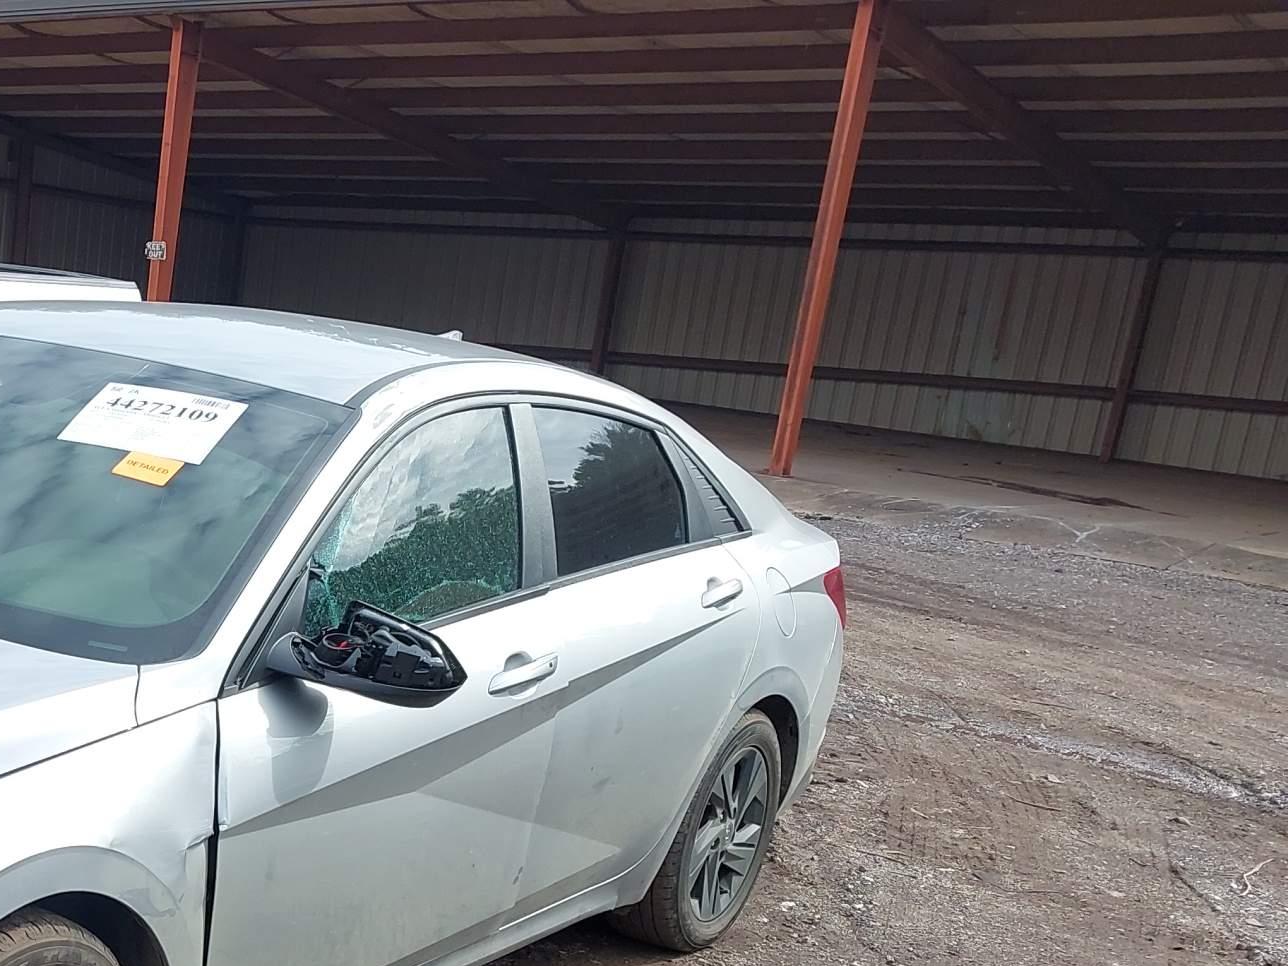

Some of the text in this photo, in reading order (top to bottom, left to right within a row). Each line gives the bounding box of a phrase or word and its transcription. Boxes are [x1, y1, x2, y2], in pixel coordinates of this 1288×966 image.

[145, 241, 164, 251] KEEP
[148, 250, 163, 258] OUT
[106, 397, 219, 423] 44272109
[126, 459, 169, 475] DETAILED
